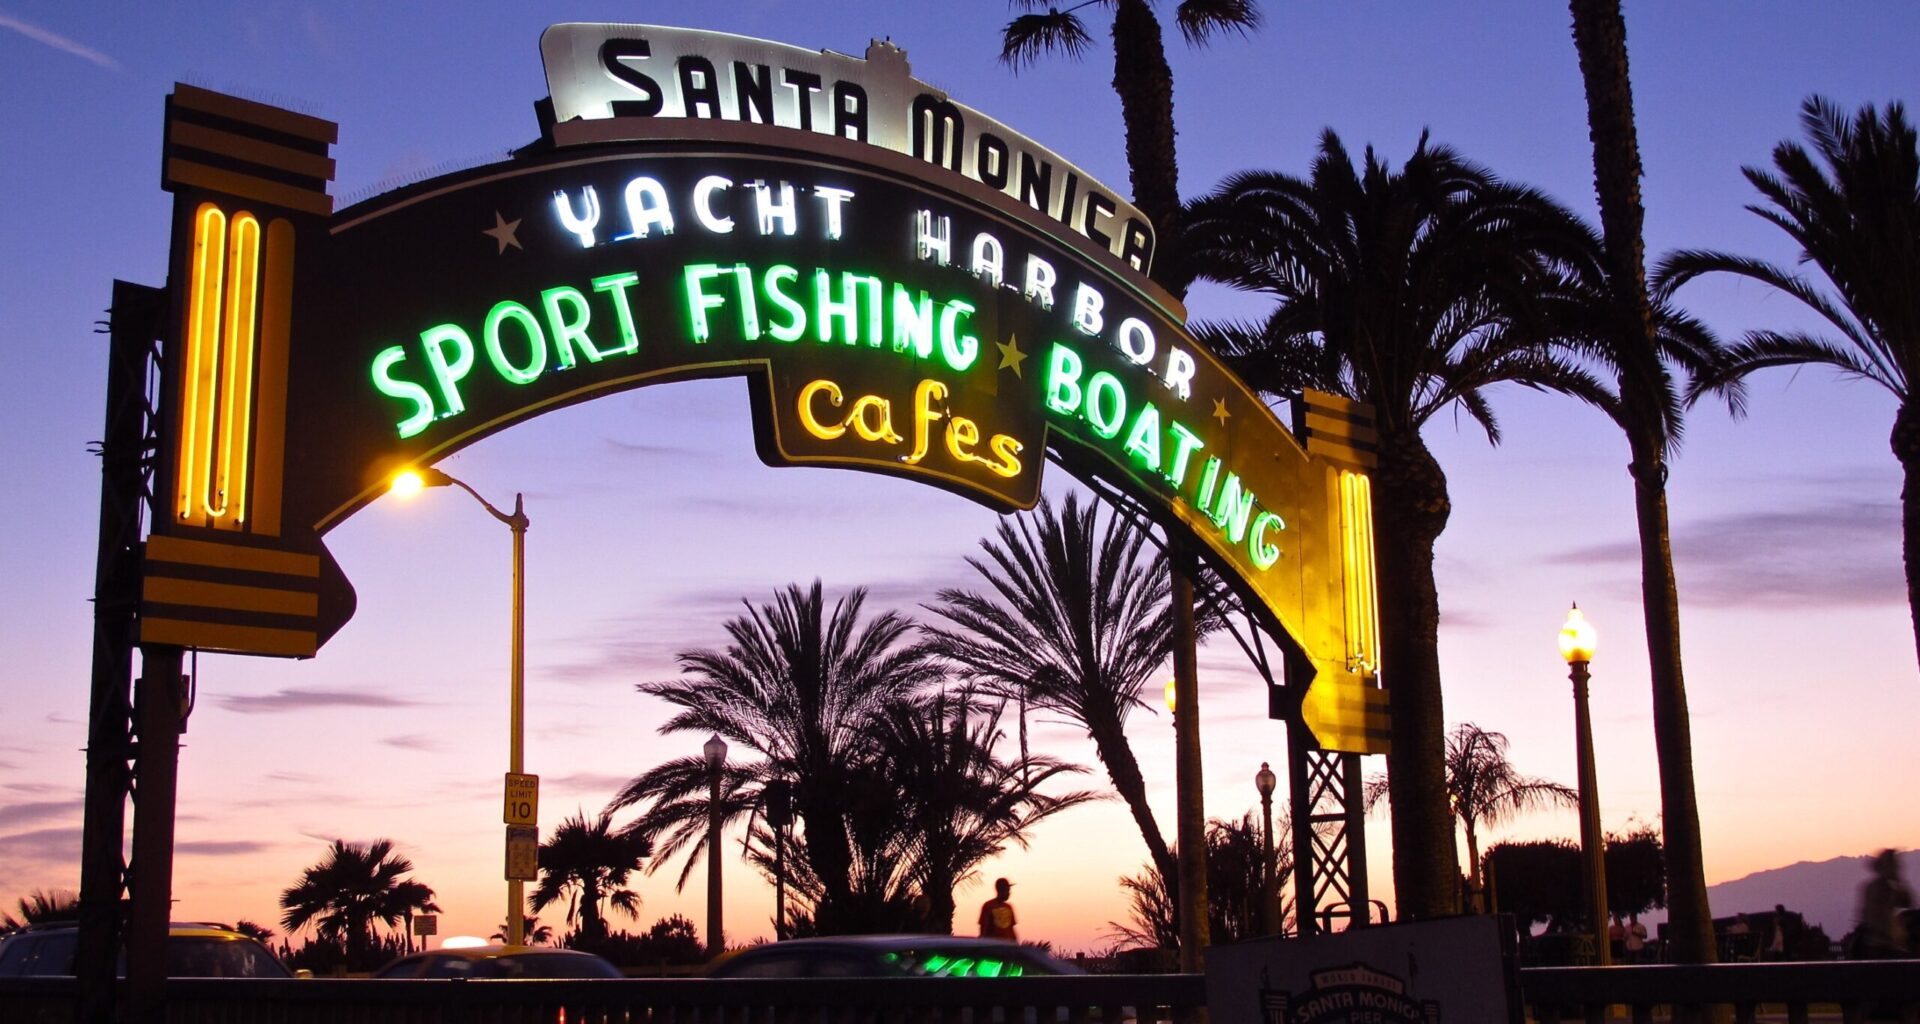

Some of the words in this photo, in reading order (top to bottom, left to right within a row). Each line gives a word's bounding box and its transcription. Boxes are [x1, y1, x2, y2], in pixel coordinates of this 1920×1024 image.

[599, 38, 868, 143] SANTA
[907, 93, 1154, 273] MONICA
[554, 175, 855, 248] YACHT
[916, 208, 1196, 402] HARBOR
[371, 272, 640, 438] SPORT
[684, 263, 979, 371] FISHING
[1046, 341, 1286, 571] BOATING
[509, 780, 535, 788] SPEED
[510, 790, 533, 798] LIMIT
[511, 802, 531, 818] 10
[1297, 991, 1354, 1024] SANTA
[1350, 1010, 1383, 1024] PIER
